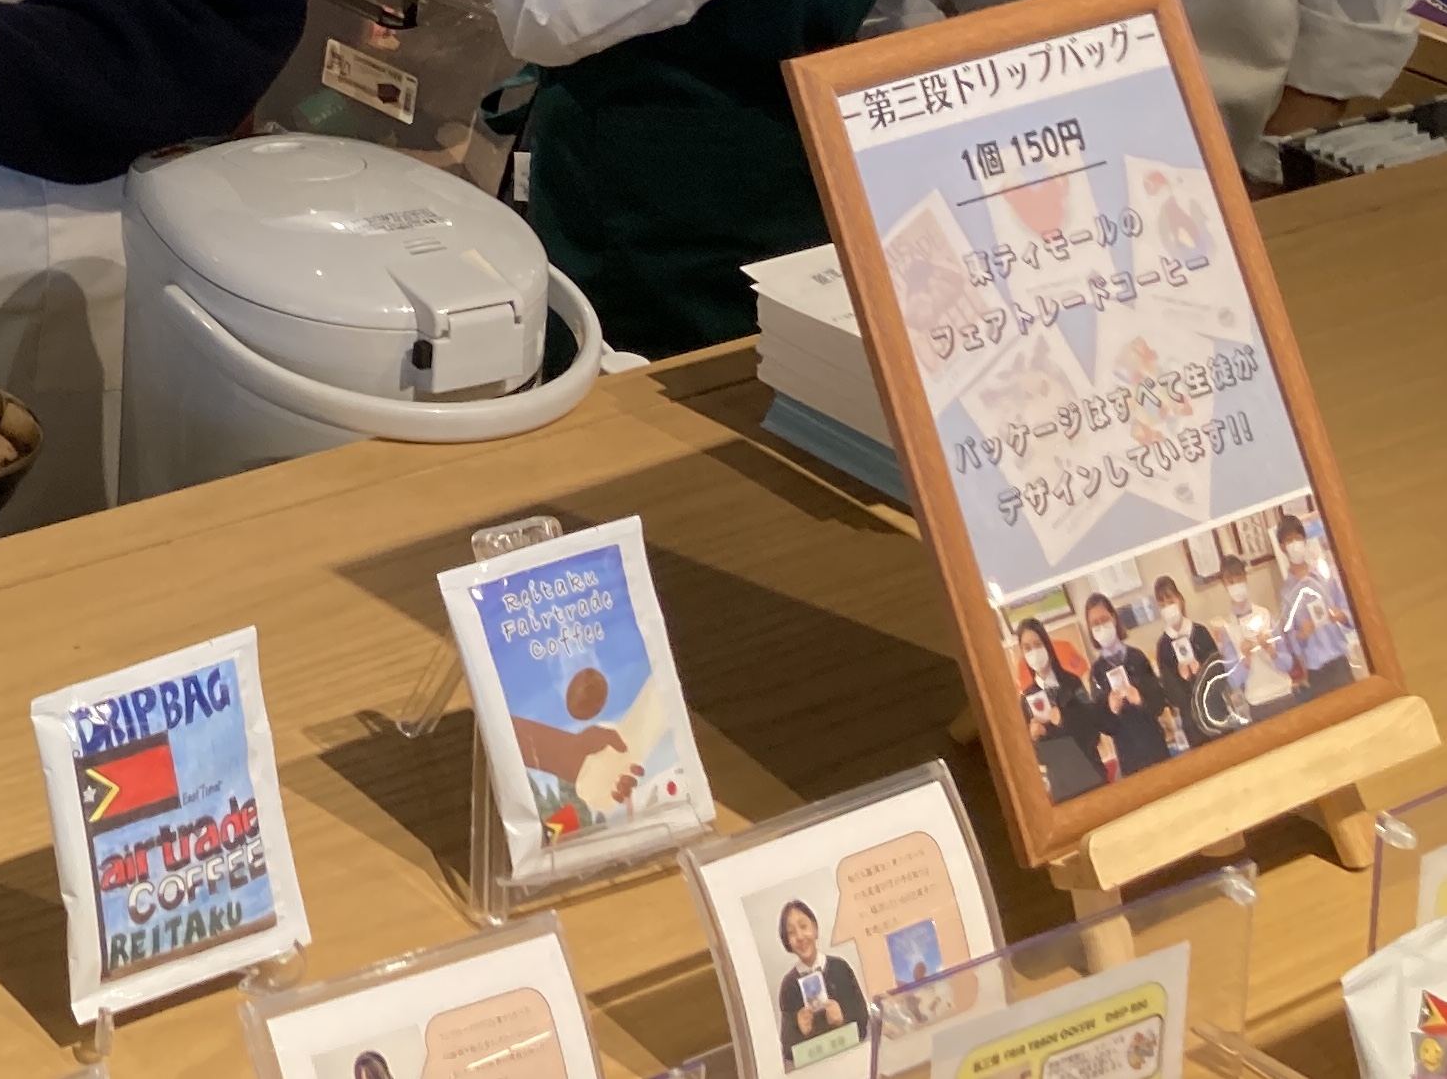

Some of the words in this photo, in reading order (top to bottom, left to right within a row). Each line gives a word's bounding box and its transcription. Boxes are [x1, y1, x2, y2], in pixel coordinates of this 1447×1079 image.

[1012, 118, 1086, 169] 150円
[963, 207, 1144, 287] 東ティモールの
[930, 253, 1212, 359] フェアトレードコーヒー
[954, 345, 1260, 475] パッケージはすべて生徒が
[128, 836, 268, 924] COFFEE
[108, 900, 244, 972] REITAKU
